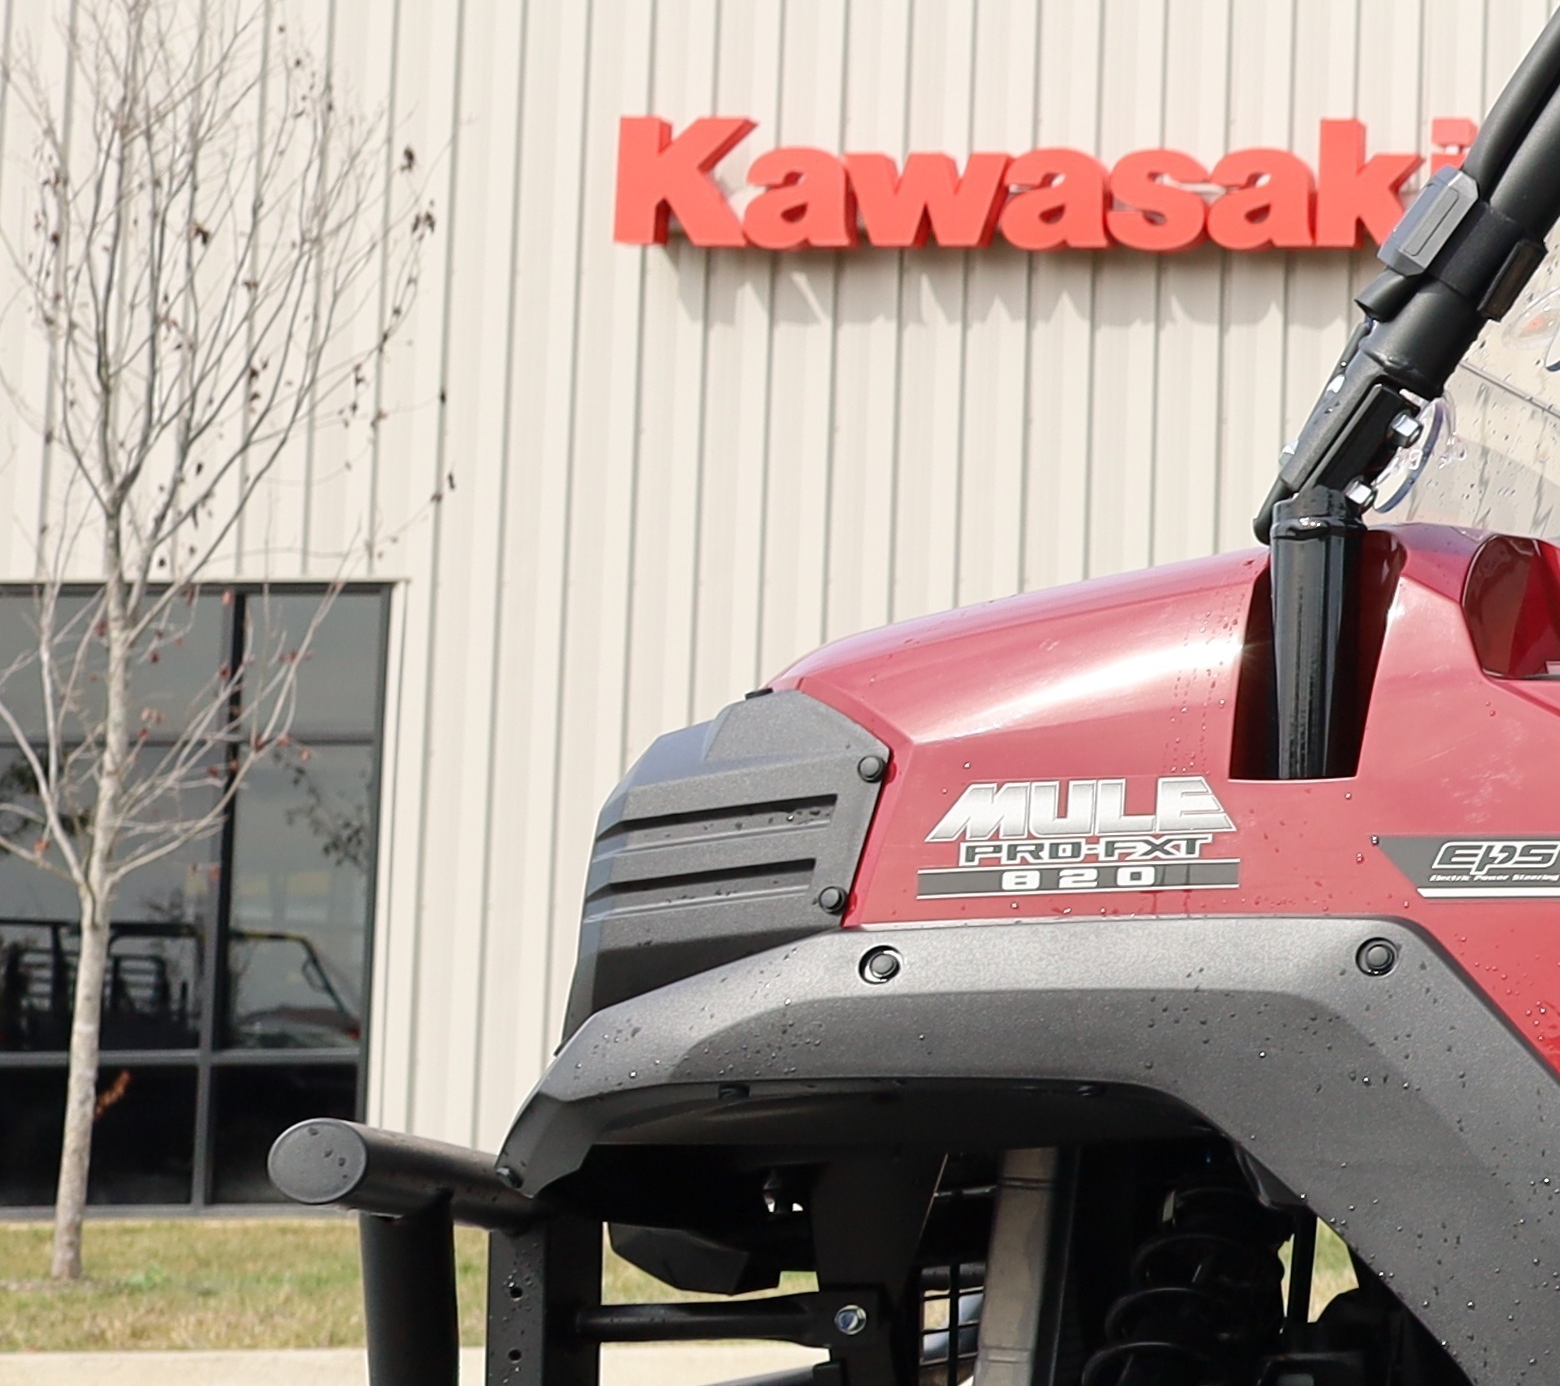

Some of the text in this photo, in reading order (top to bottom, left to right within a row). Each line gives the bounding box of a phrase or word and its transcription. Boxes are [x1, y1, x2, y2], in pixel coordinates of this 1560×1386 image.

[924, 776, 1237, 842] MULE
[959, 833, 1213, 866] PRO-FXT
[1429, 874, 1560, 882] Electric Power Steering
